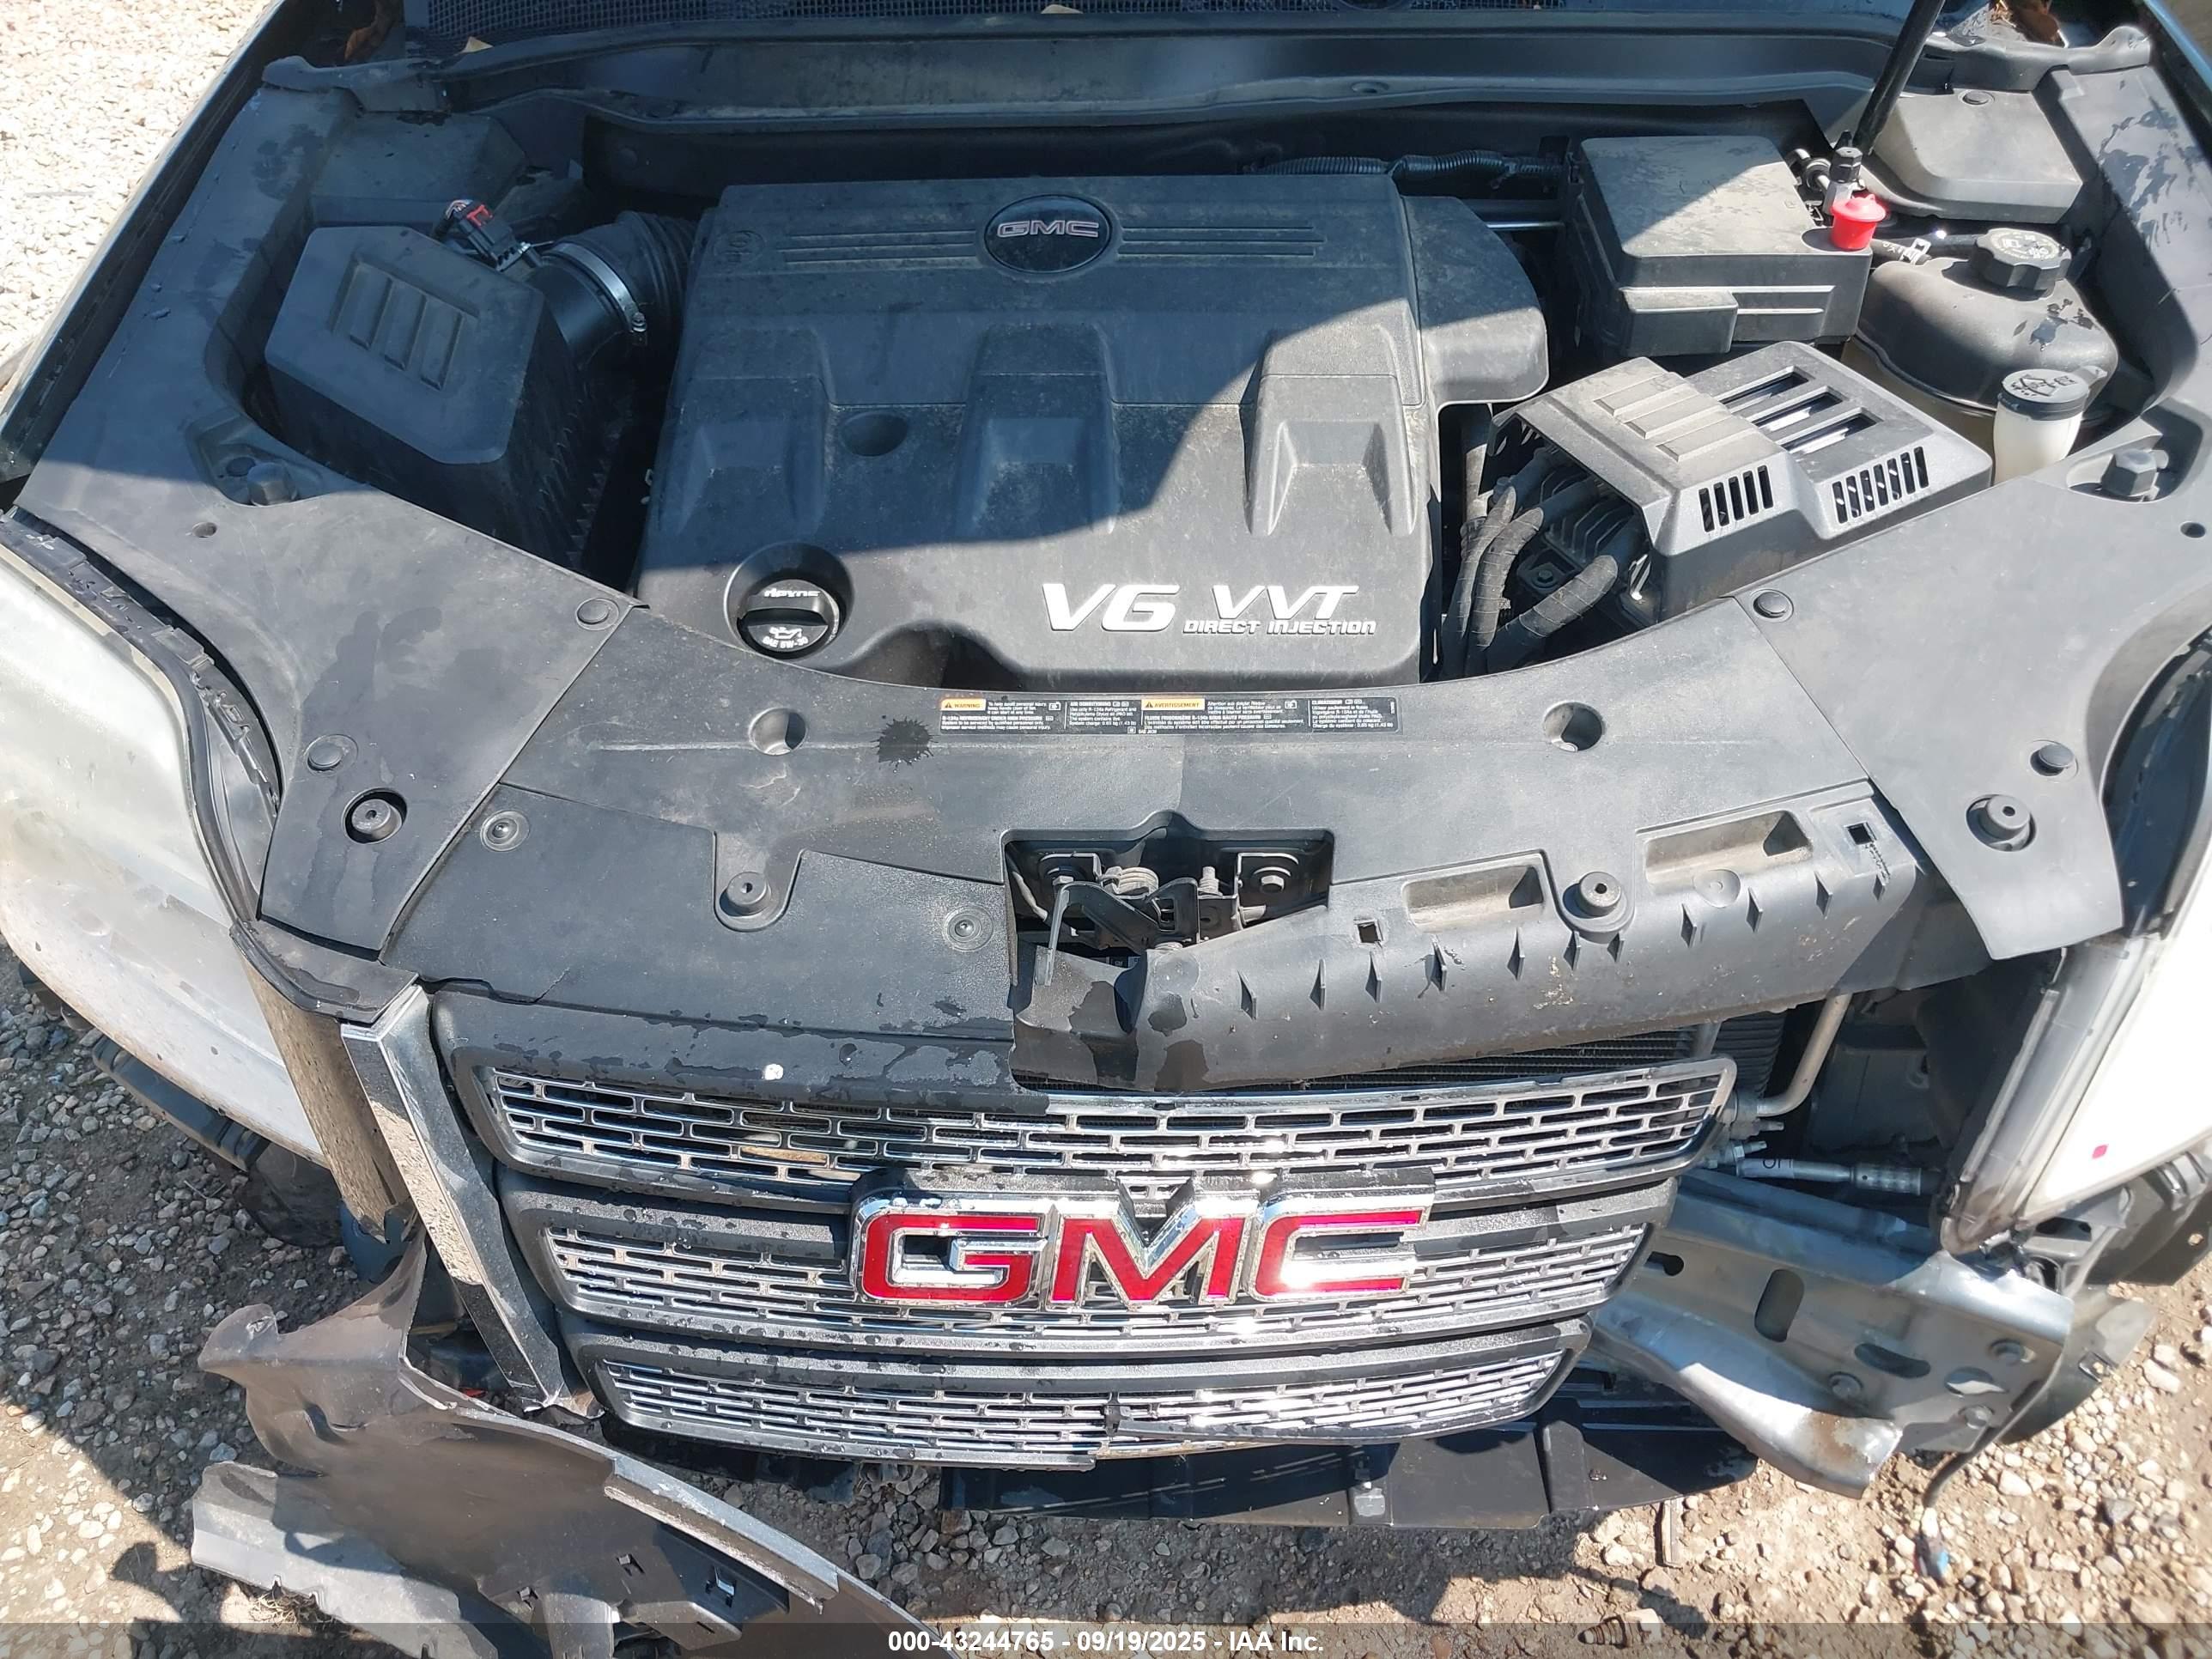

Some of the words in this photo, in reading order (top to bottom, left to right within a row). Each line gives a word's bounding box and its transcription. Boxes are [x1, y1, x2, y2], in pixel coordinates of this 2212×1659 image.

[997, 220, 1099, 238] GMC
[1042, 583, 1182, 632] V6
[1211, 585, 1360, 620] VVT
[1182, 621, 1261, 635] DIRECT
[1267, 621, 1376, 635] INJECTION
[857, 1199, 1429, 1310] GMC
